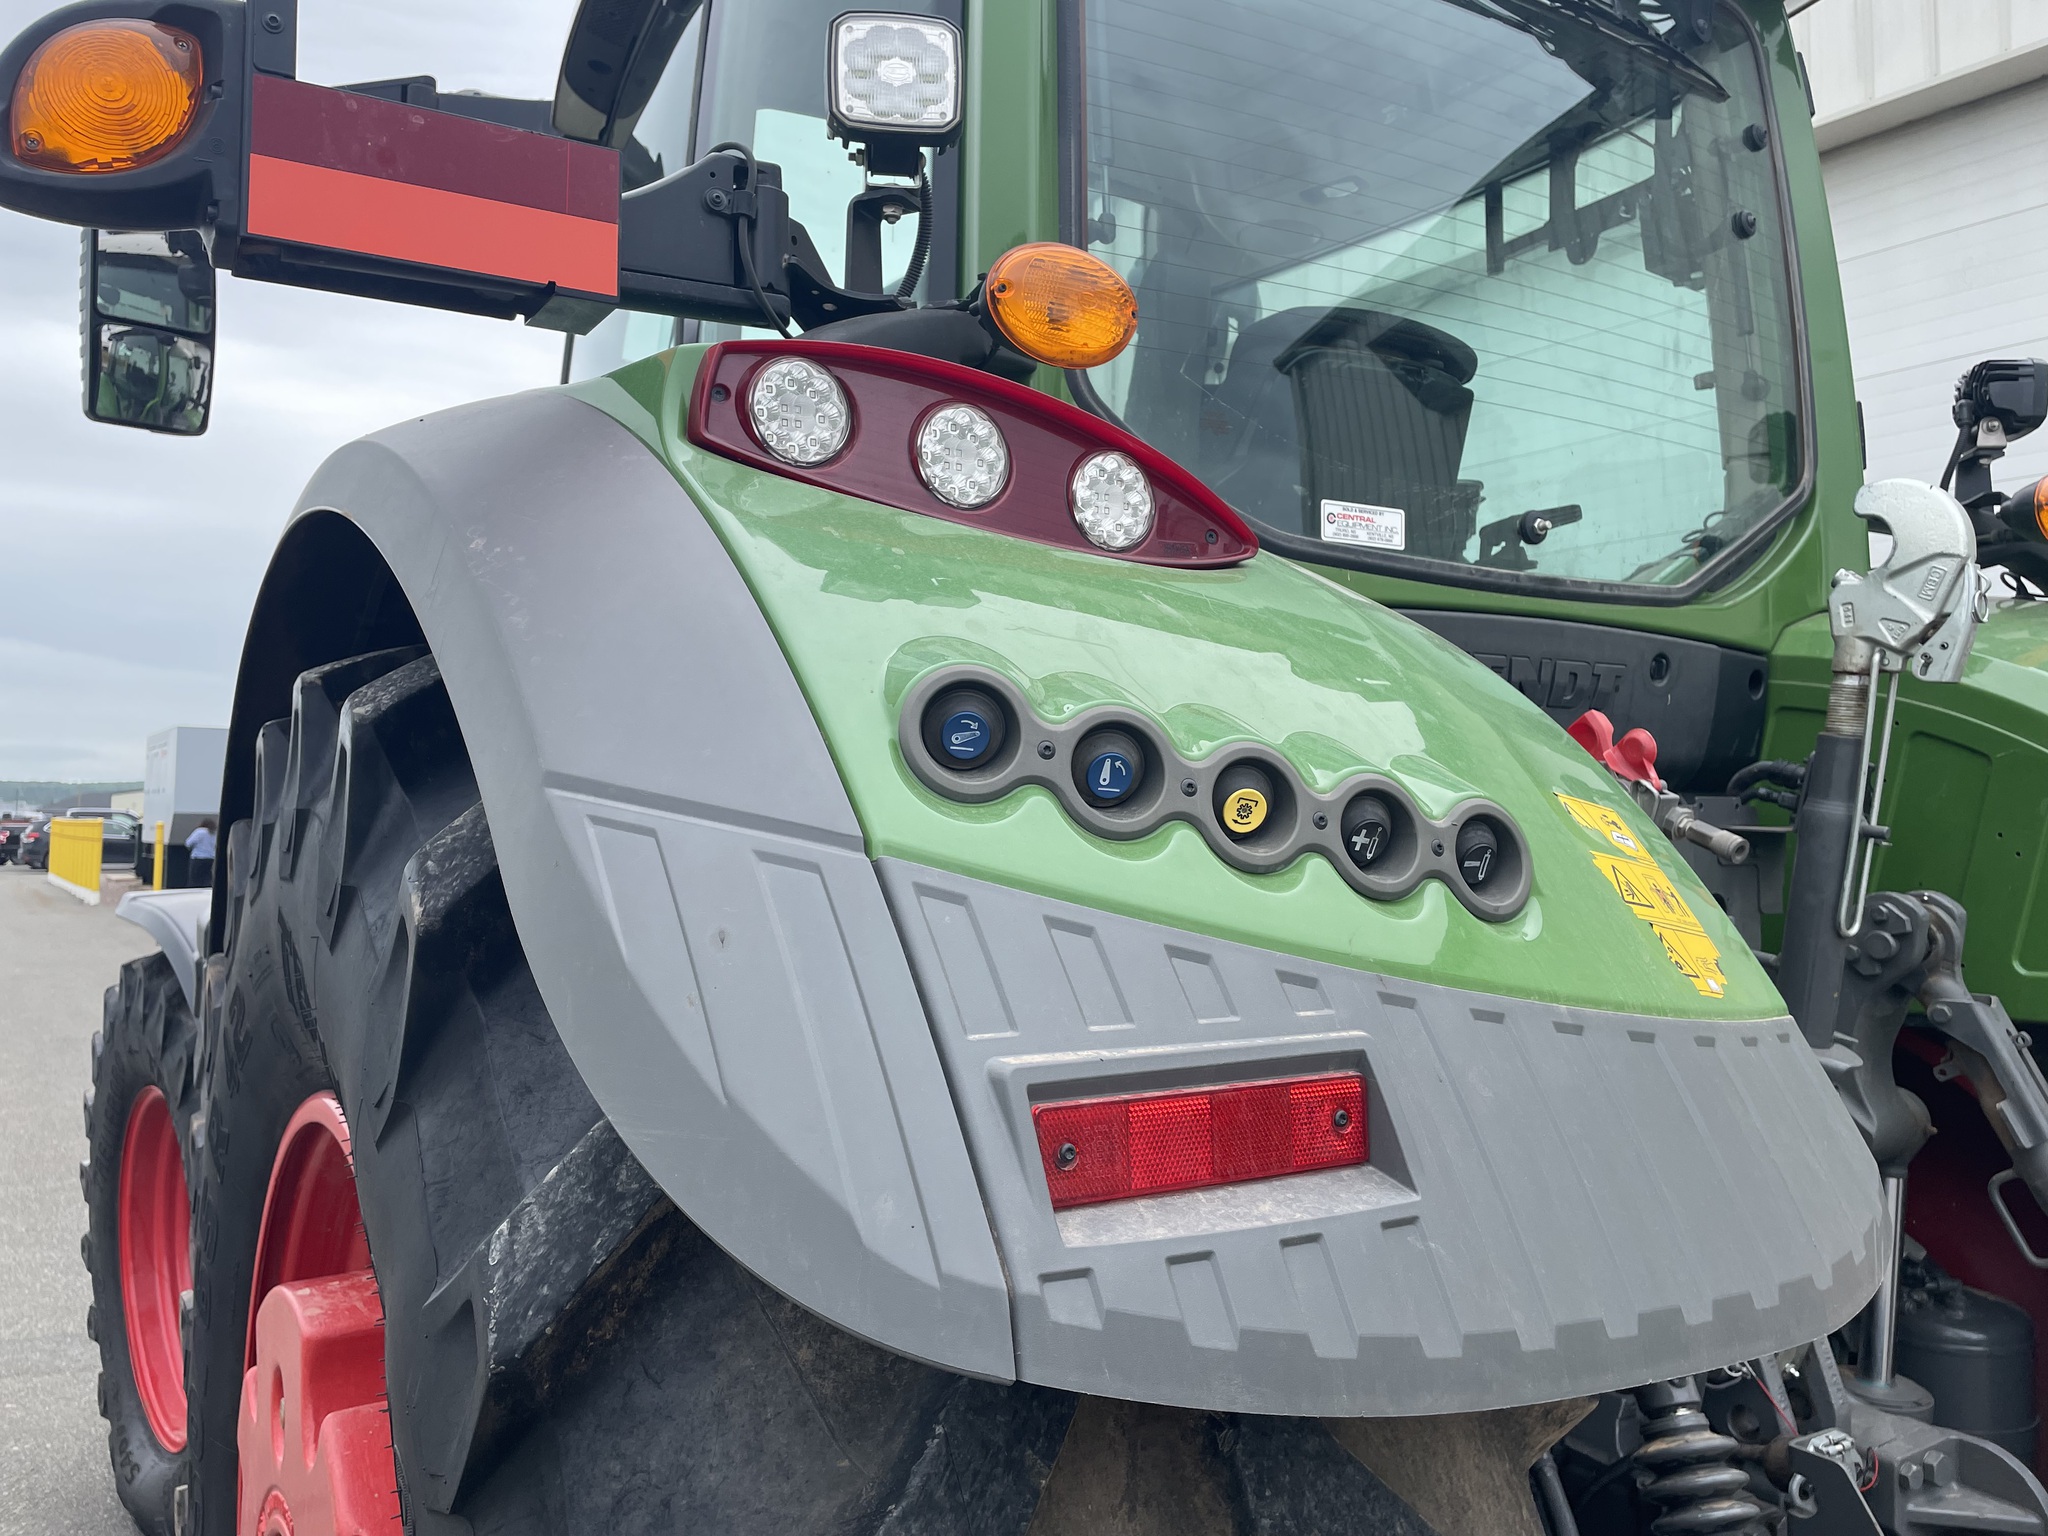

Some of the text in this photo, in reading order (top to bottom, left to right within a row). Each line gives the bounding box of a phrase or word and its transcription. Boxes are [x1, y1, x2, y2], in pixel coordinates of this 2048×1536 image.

[1337, 512, 1376, 524] CENTRAL
[1337, 520, 1382, 532] EQUIPMENT
[1921, 569, 1942, 599] CBM
